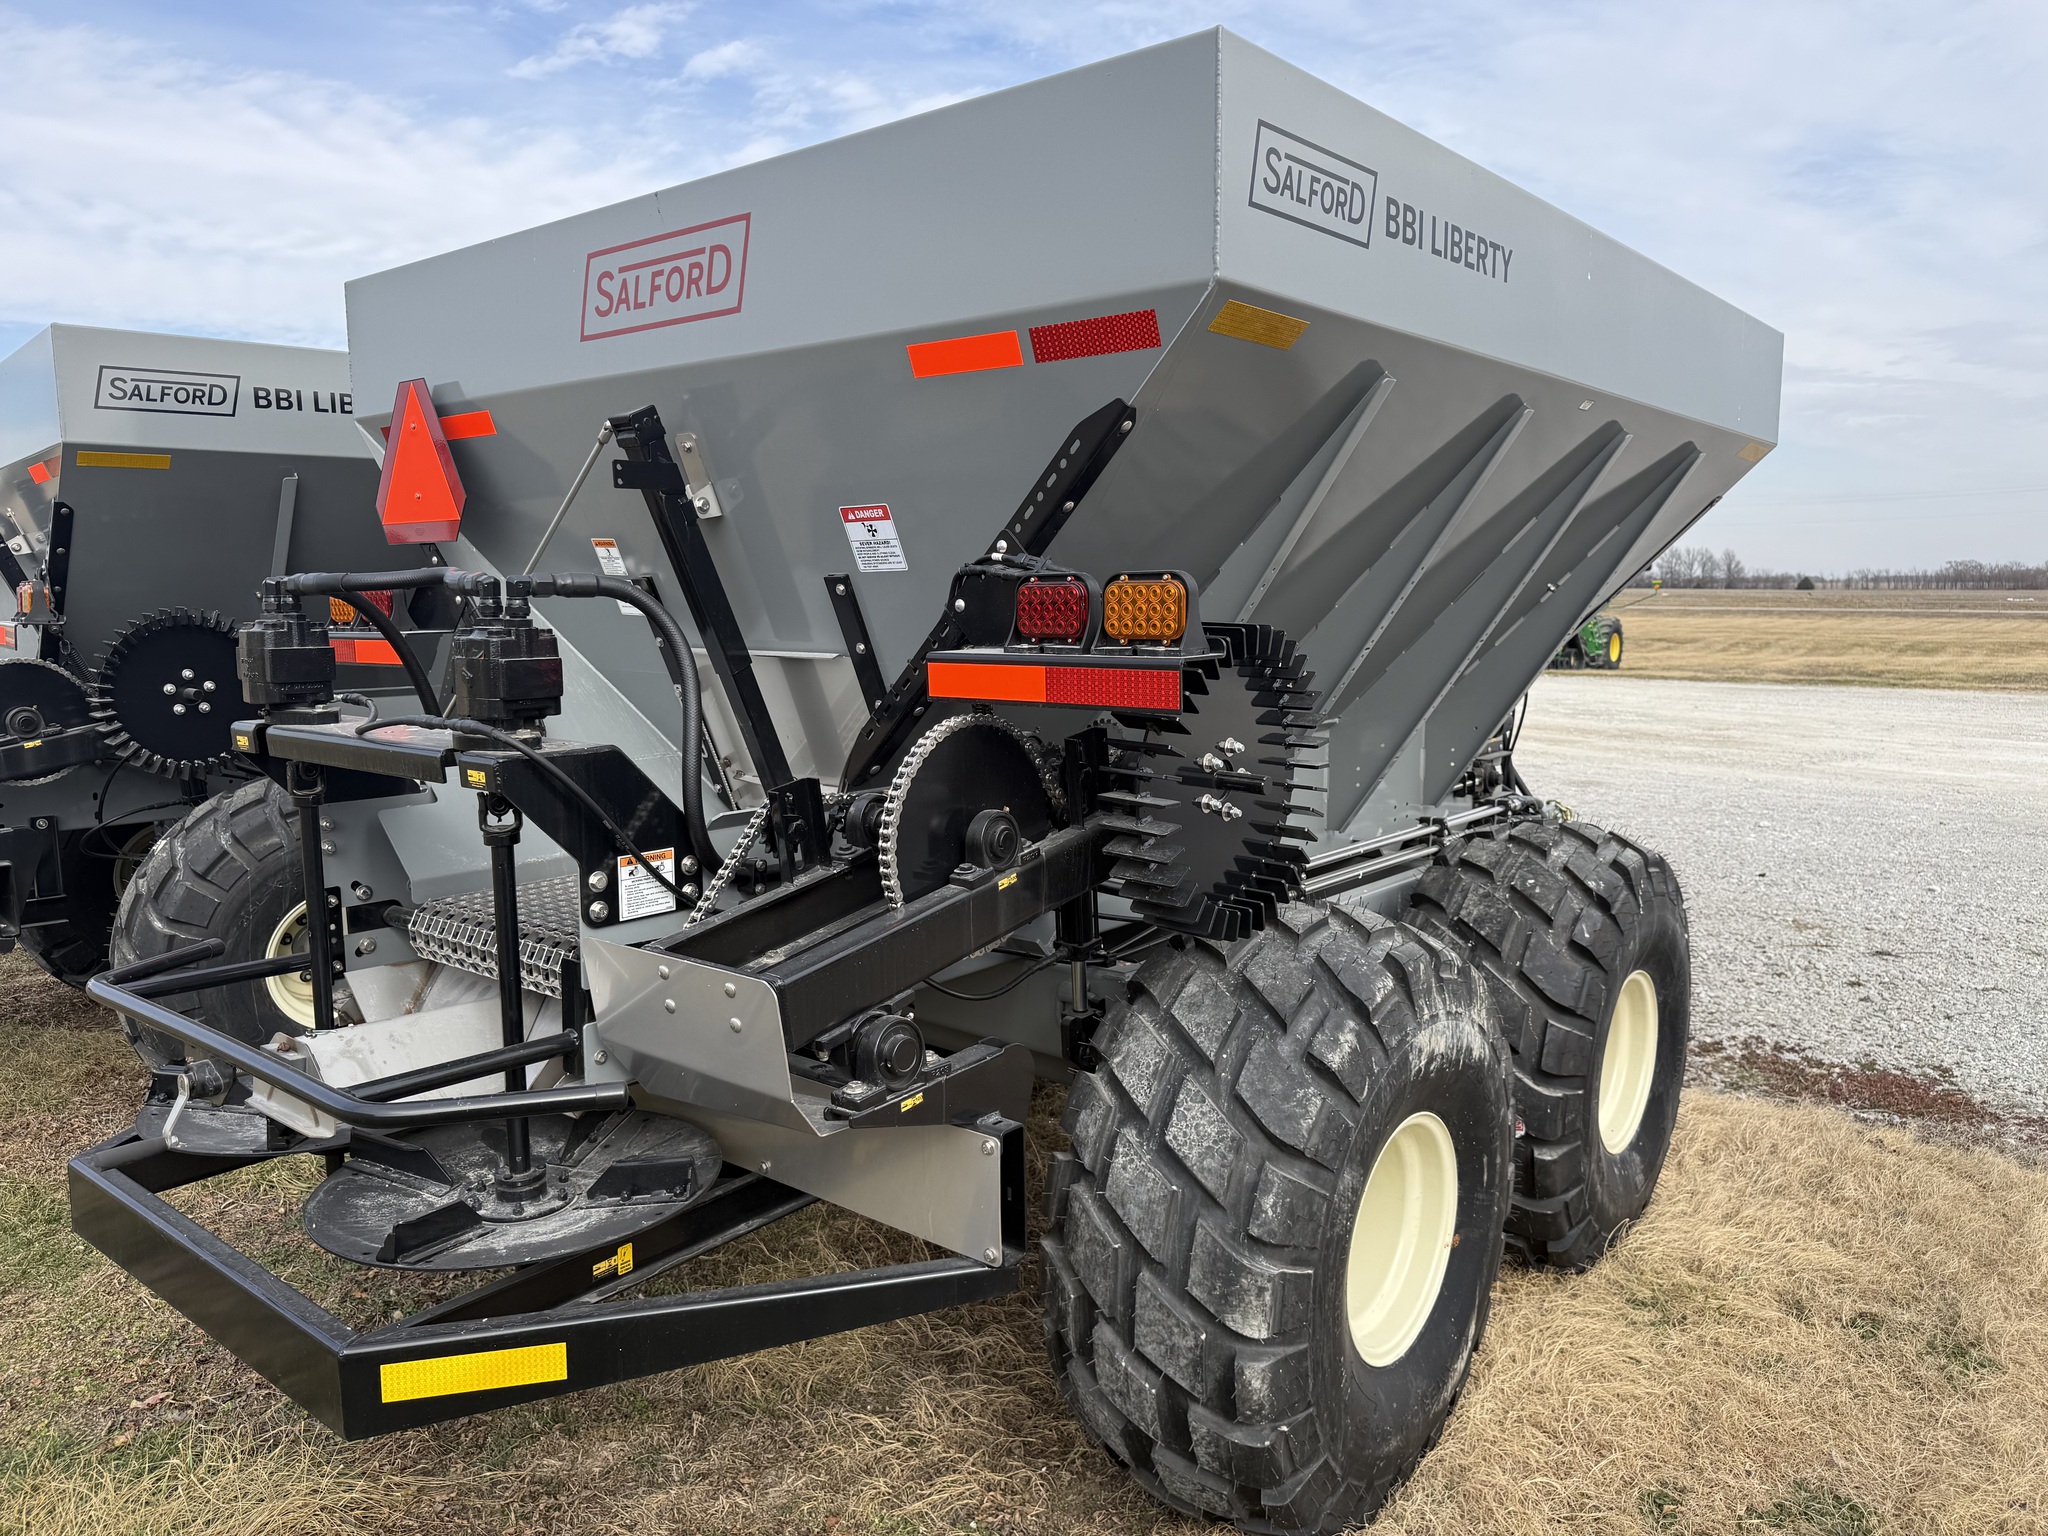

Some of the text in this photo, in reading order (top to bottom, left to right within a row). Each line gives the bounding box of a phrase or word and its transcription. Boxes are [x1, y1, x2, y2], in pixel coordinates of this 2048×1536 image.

[1262, 146, 1514, 283] SALFORD BBI LIBERTY
[594, 243, 732, 318] SALFORD
[108, 376, 228, 406] SALFORD
[253, 386, 303, 412] BBI
[854, 508, 885, 519] DANGER
[635, 853, 666, 865] RNING
